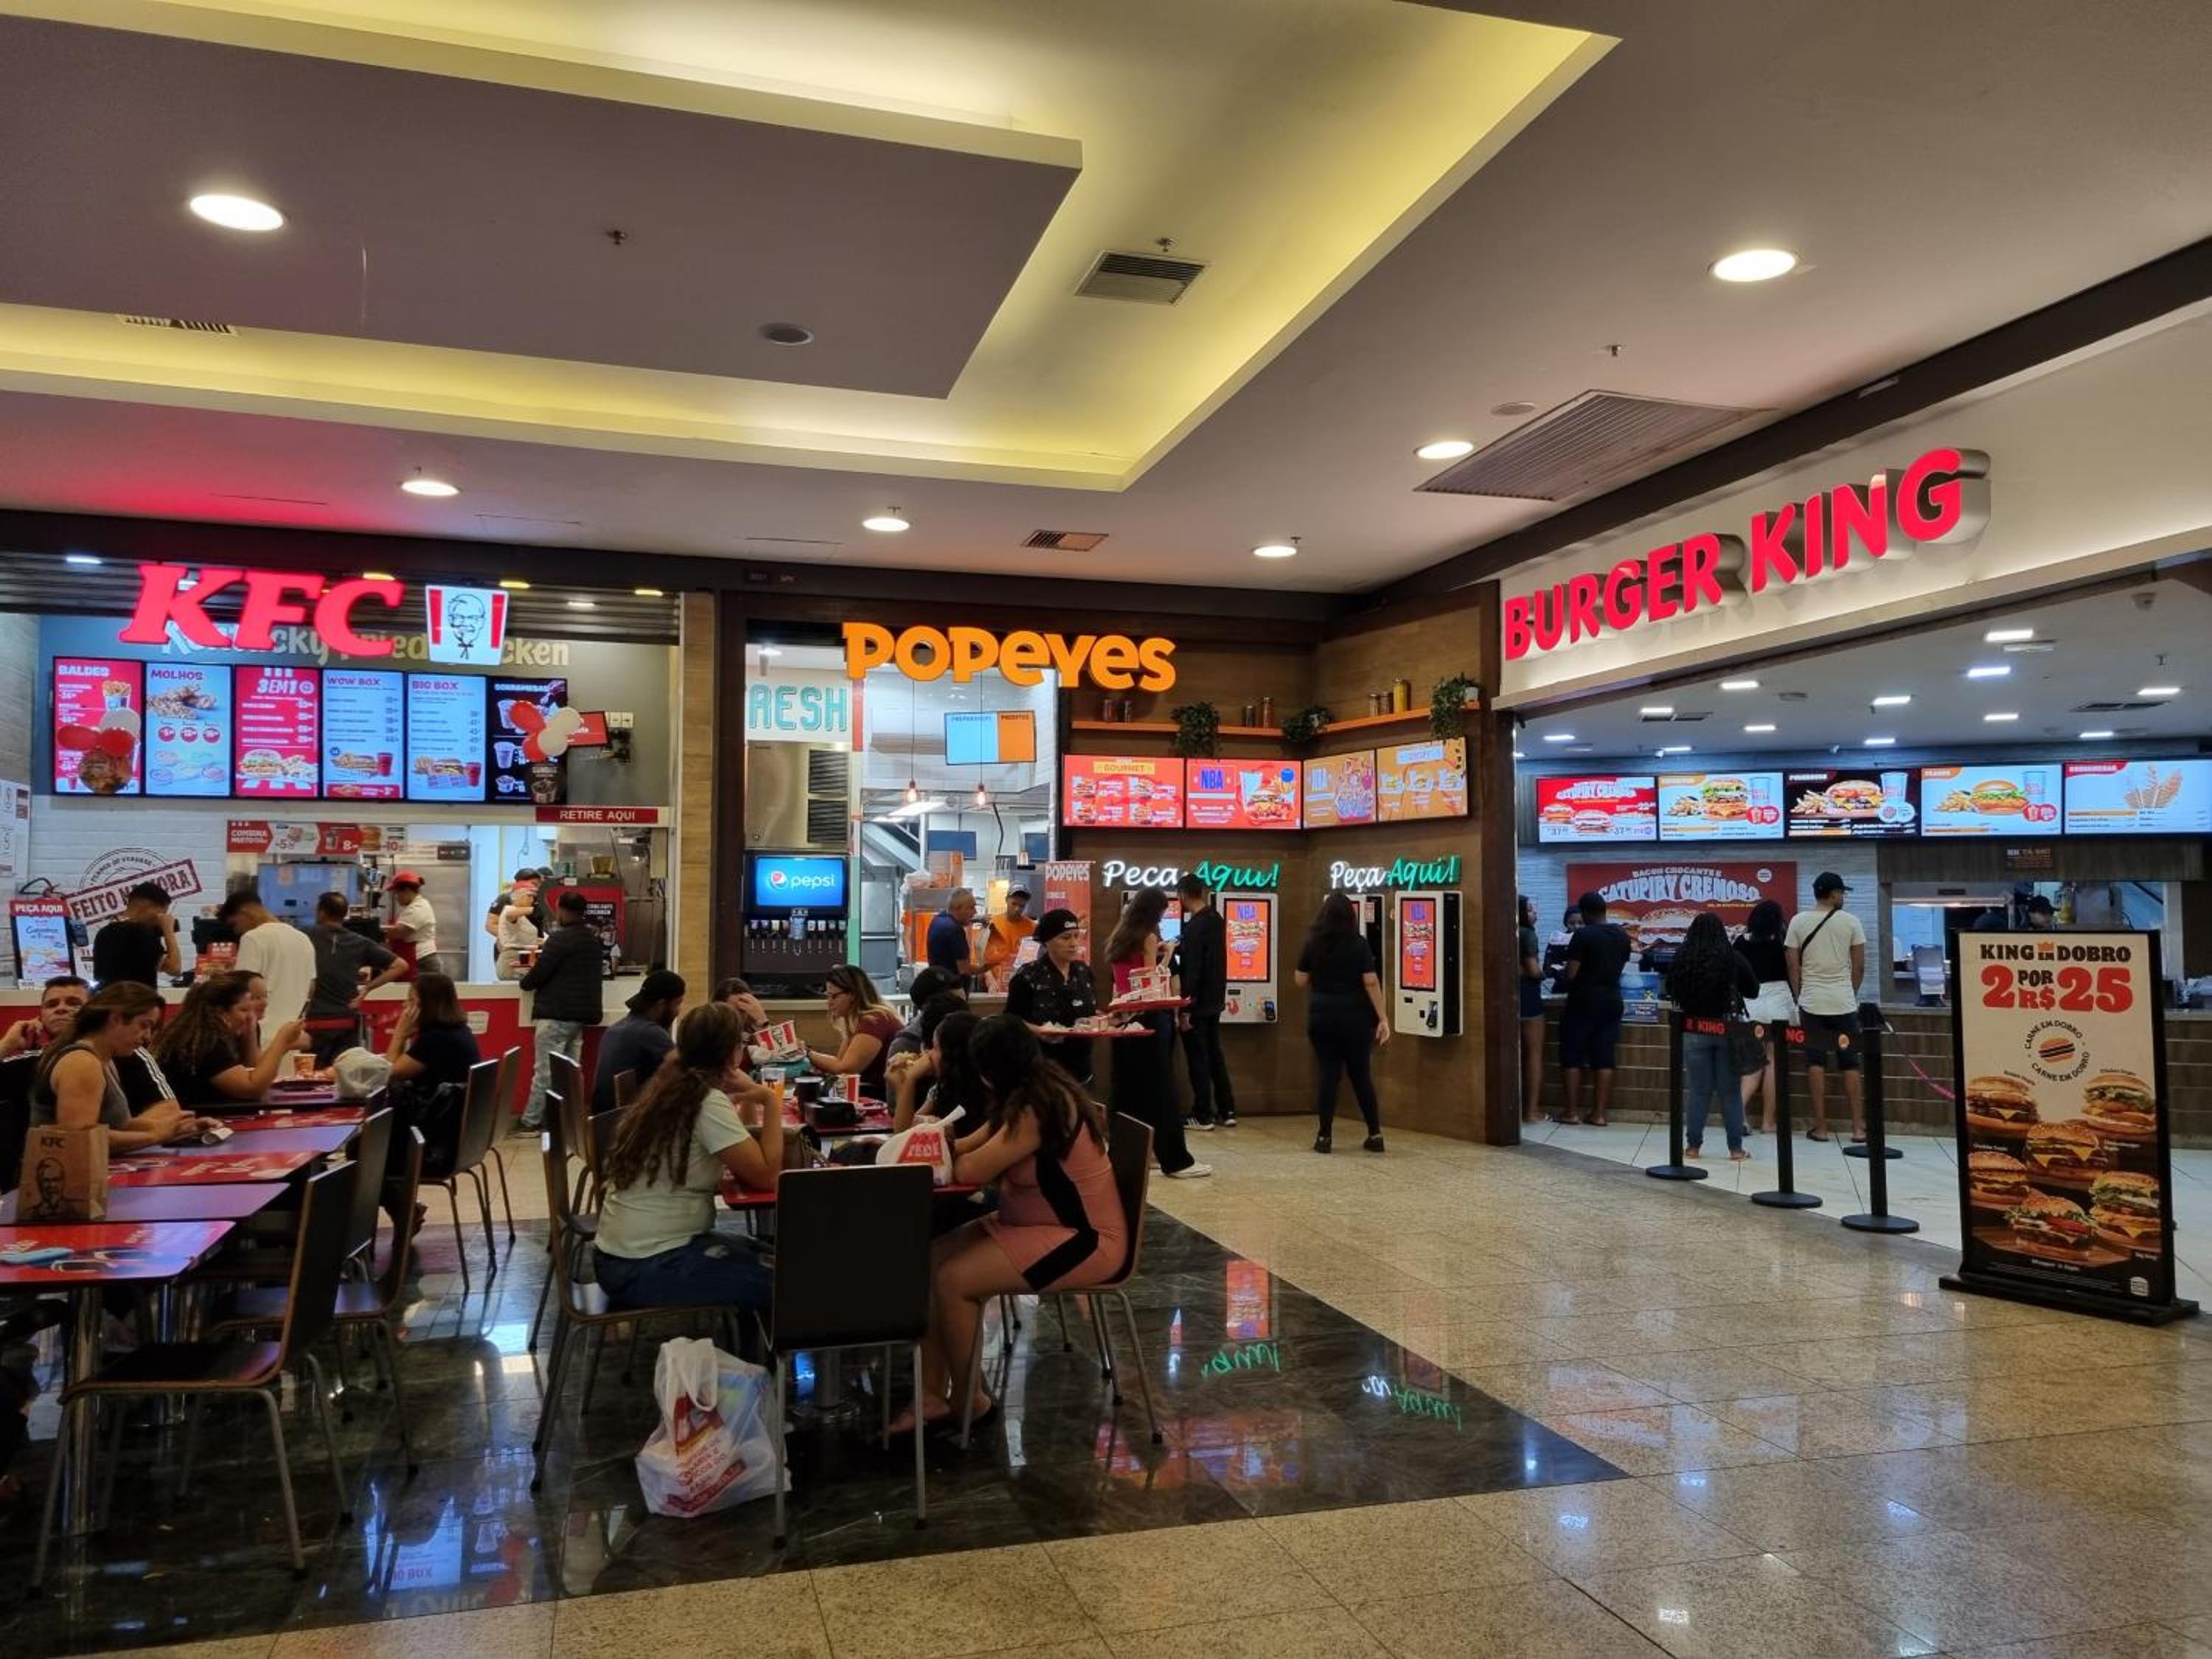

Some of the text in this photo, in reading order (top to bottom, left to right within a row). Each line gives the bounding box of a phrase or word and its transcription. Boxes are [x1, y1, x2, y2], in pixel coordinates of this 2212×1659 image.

[1504, 446, 1963, 661] BURGER KING
[118, 561, 406, 657] KFC
[150, 669, 204, 681] MOLHOS
[327, 676, 380, 686] WOW BOX
[411, 680, 459, 691] BIG BOX
[1200, 768, 1225, 790] NBA
[560, 810, 636, 821] RETIRE AQUI
[790, 874, 835, 890] pepsi
[1194, 859, 1281, 893] Aqui!
[1330, 855, 1458, 893] Peça Aqui!
[1598, 874, 1678, 902] CATUPIRY
[1678, 872, 1762, 902] CREMOSO
[70, 891, 118, 921] FEITO
[1980, 943, 2035, 960] KING
[2056, 945, 2132, 963] DOBRO
[1980, 963, 2054, 1009] 2 POR
[2018, 966, 2134, 1014] R$ 25
[1698, 1020, 1726, 1035] KING
[2024, 1020, 2083, 1050] CARNE EM DOBRO
[2031, 1051, 2091, 1082] CARNE EM DOBRO
[41, 1135, 66, 1149] KFC
